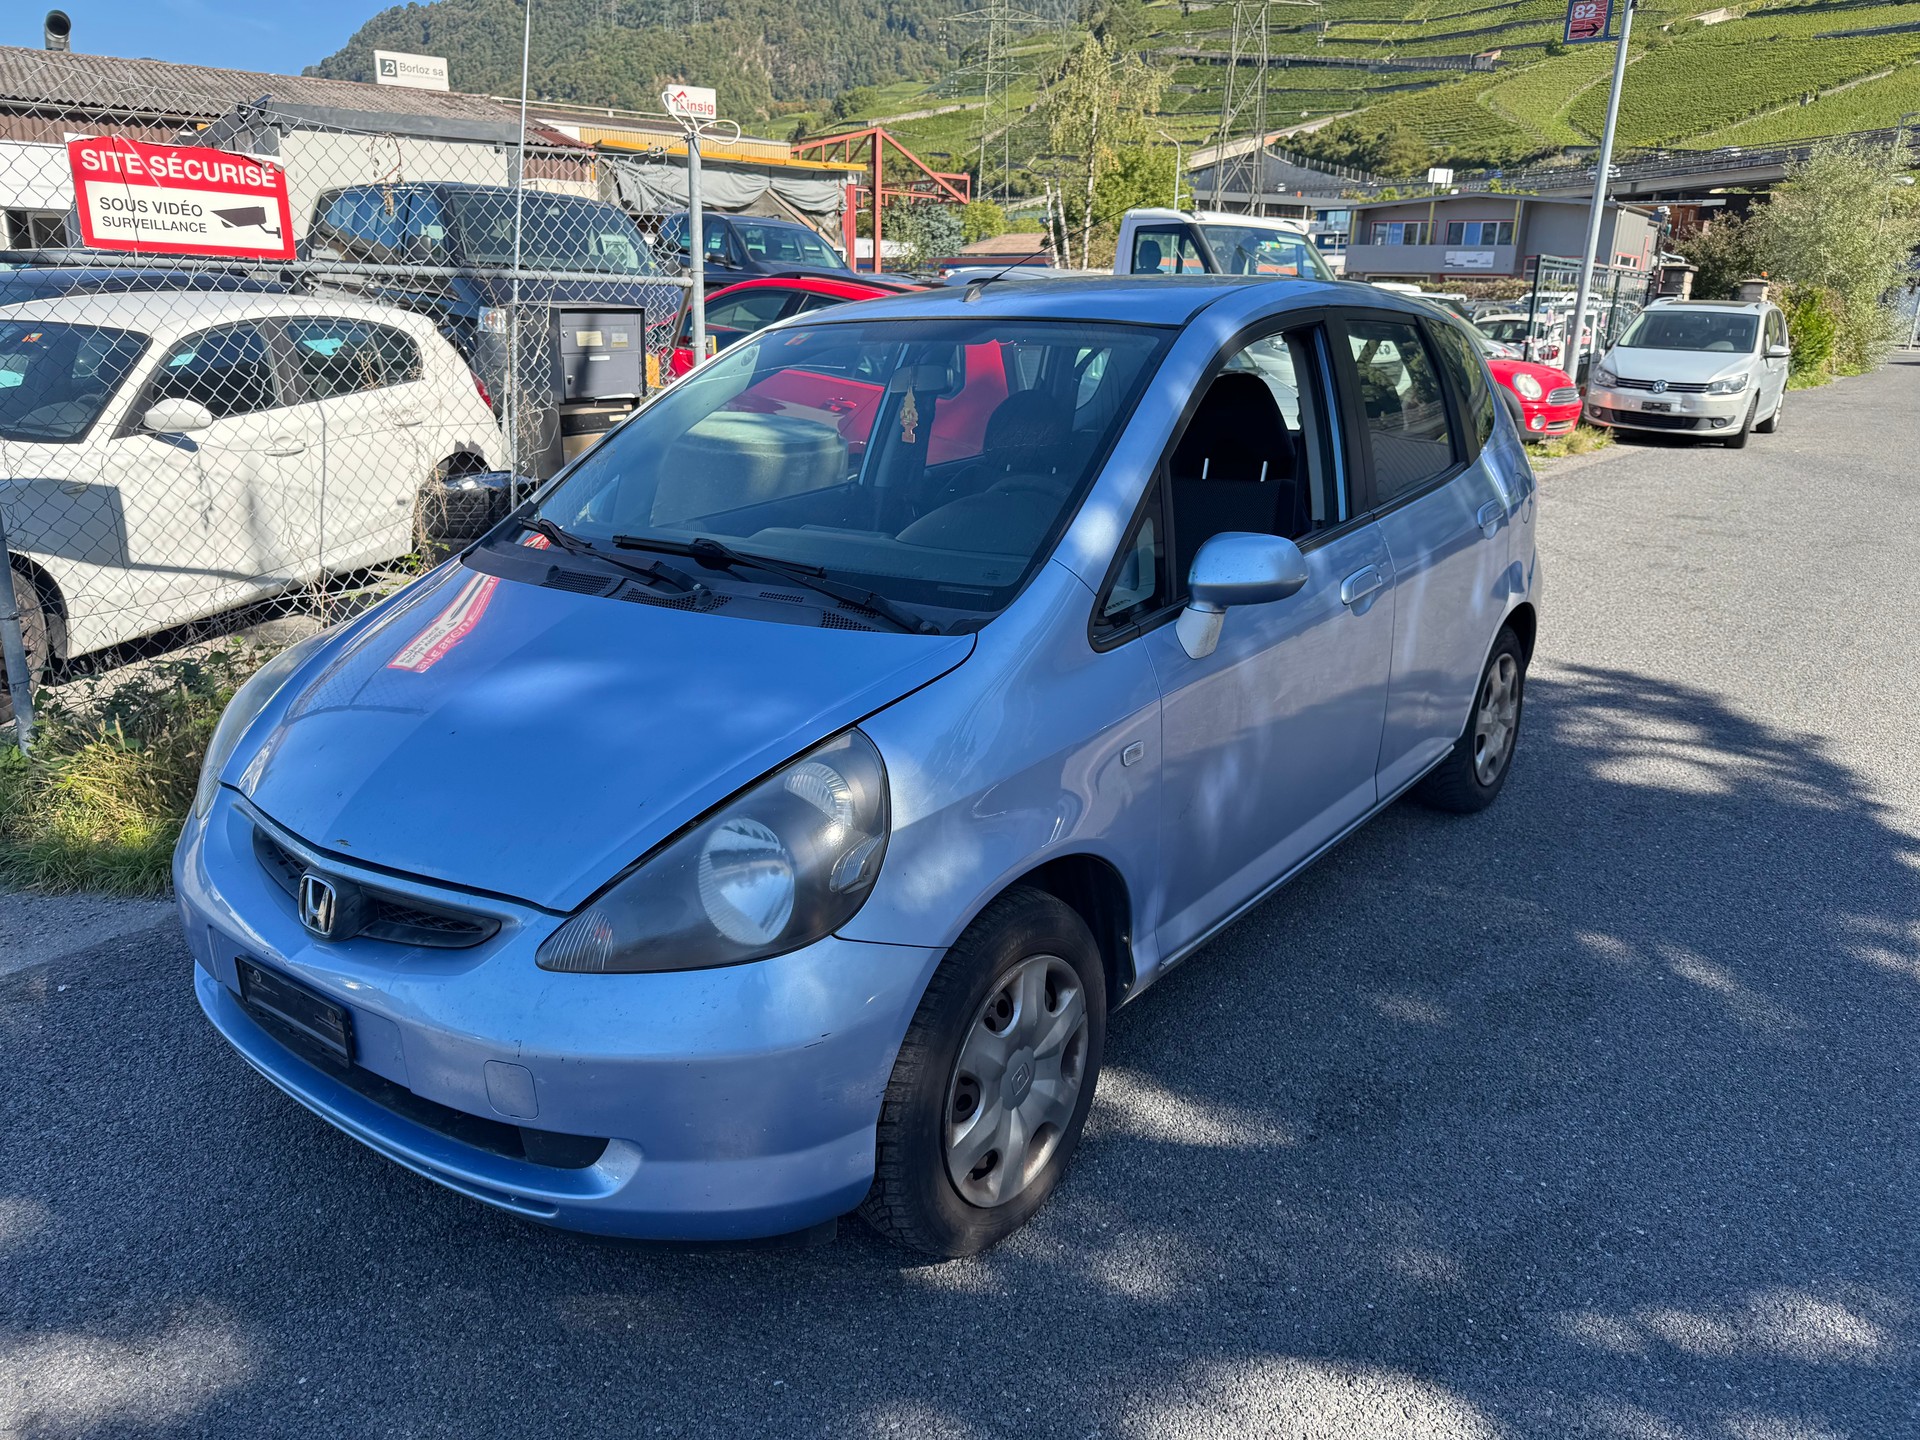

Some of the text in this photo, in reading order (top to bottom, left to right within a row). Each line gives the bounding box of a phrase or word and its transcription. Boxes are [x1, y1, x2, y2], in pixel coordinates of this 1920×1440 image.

[1574, 3, 1597, 19] 82
[399, 62, 430, 75] Borloz
[432, 68, 444, 76] sa
[80, 148, 277, 188] SITE SÉCURISÉ
[99, 196, 203, 217] SOUS VIDÉO
[102, 215, 207, 233] SURVEILLANCE
